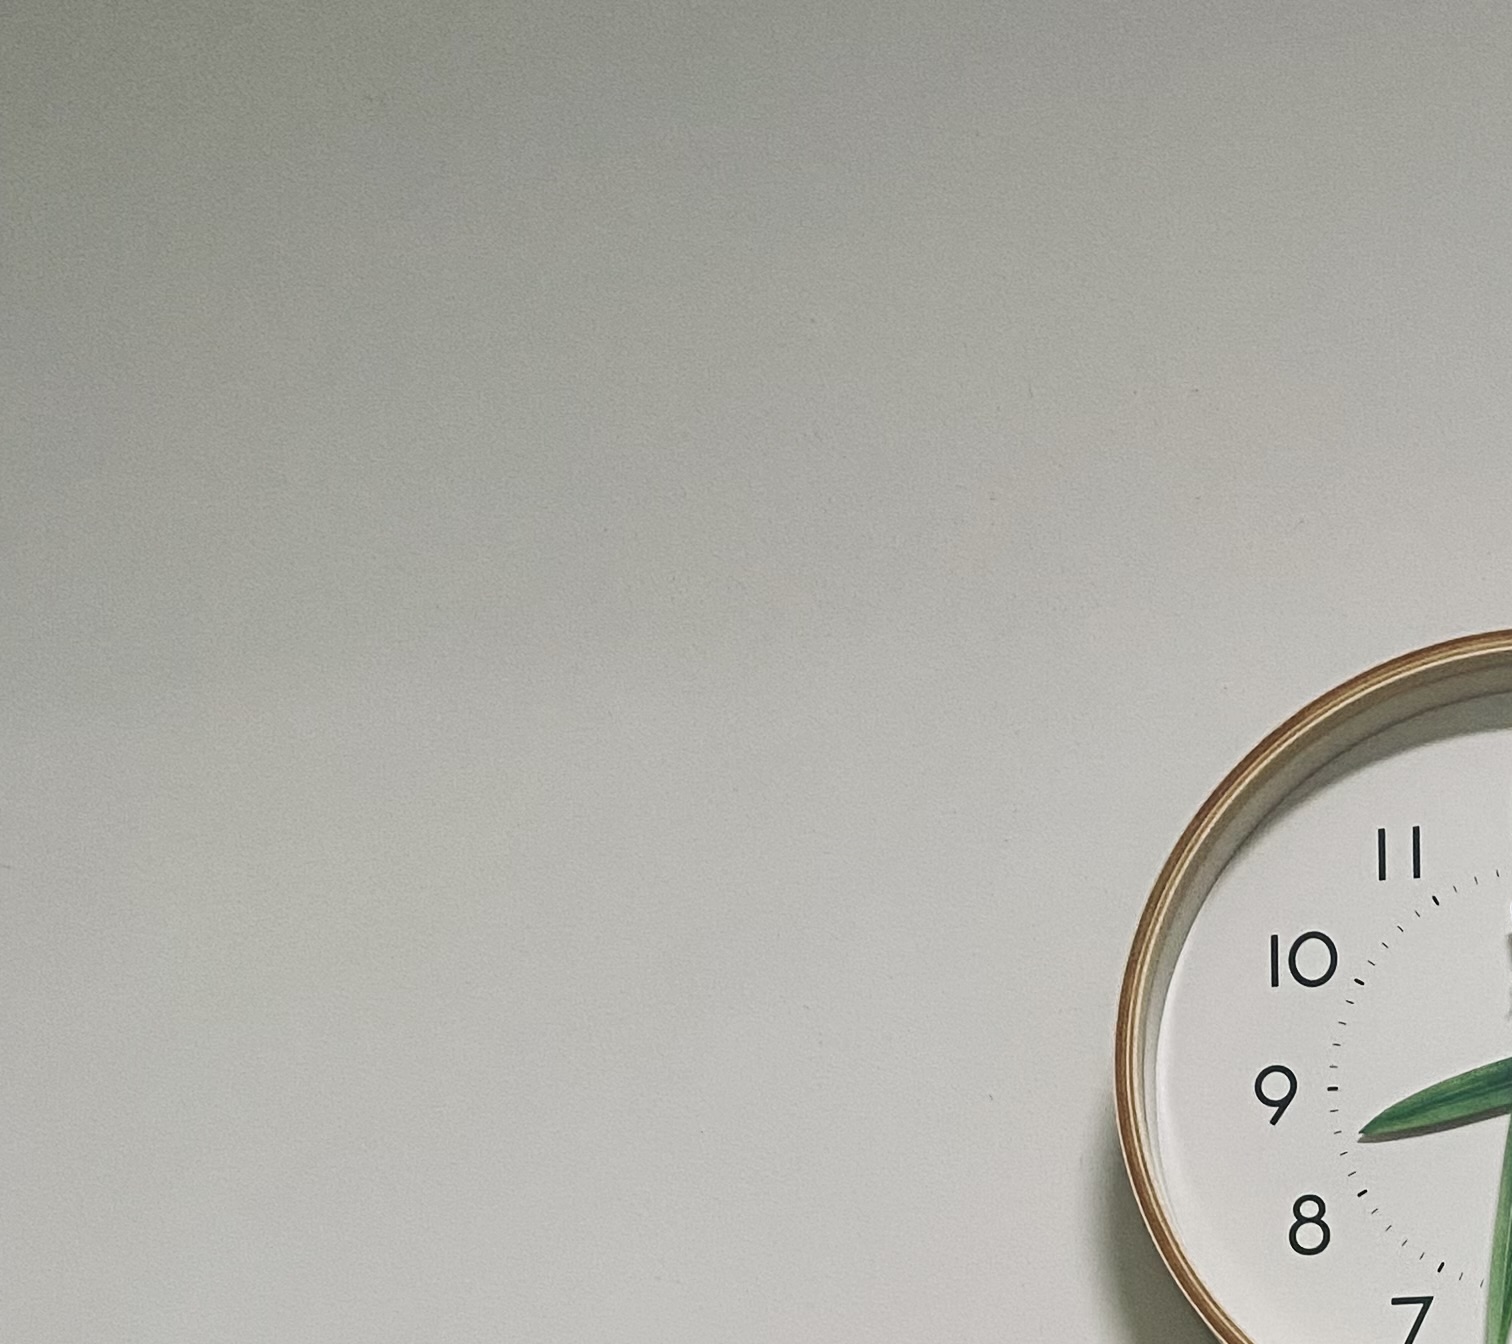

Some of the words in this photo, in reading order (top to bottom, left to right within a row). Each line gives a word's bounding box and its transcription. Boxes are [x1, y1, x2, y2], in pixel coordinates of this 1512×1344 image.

[1377, 825, 1421, 882] 11
[1270, 930, 1338, 988] 10
[1254, 1064, 1298, 1126] 9
[1288, 1194, 1331, 1256] 8
